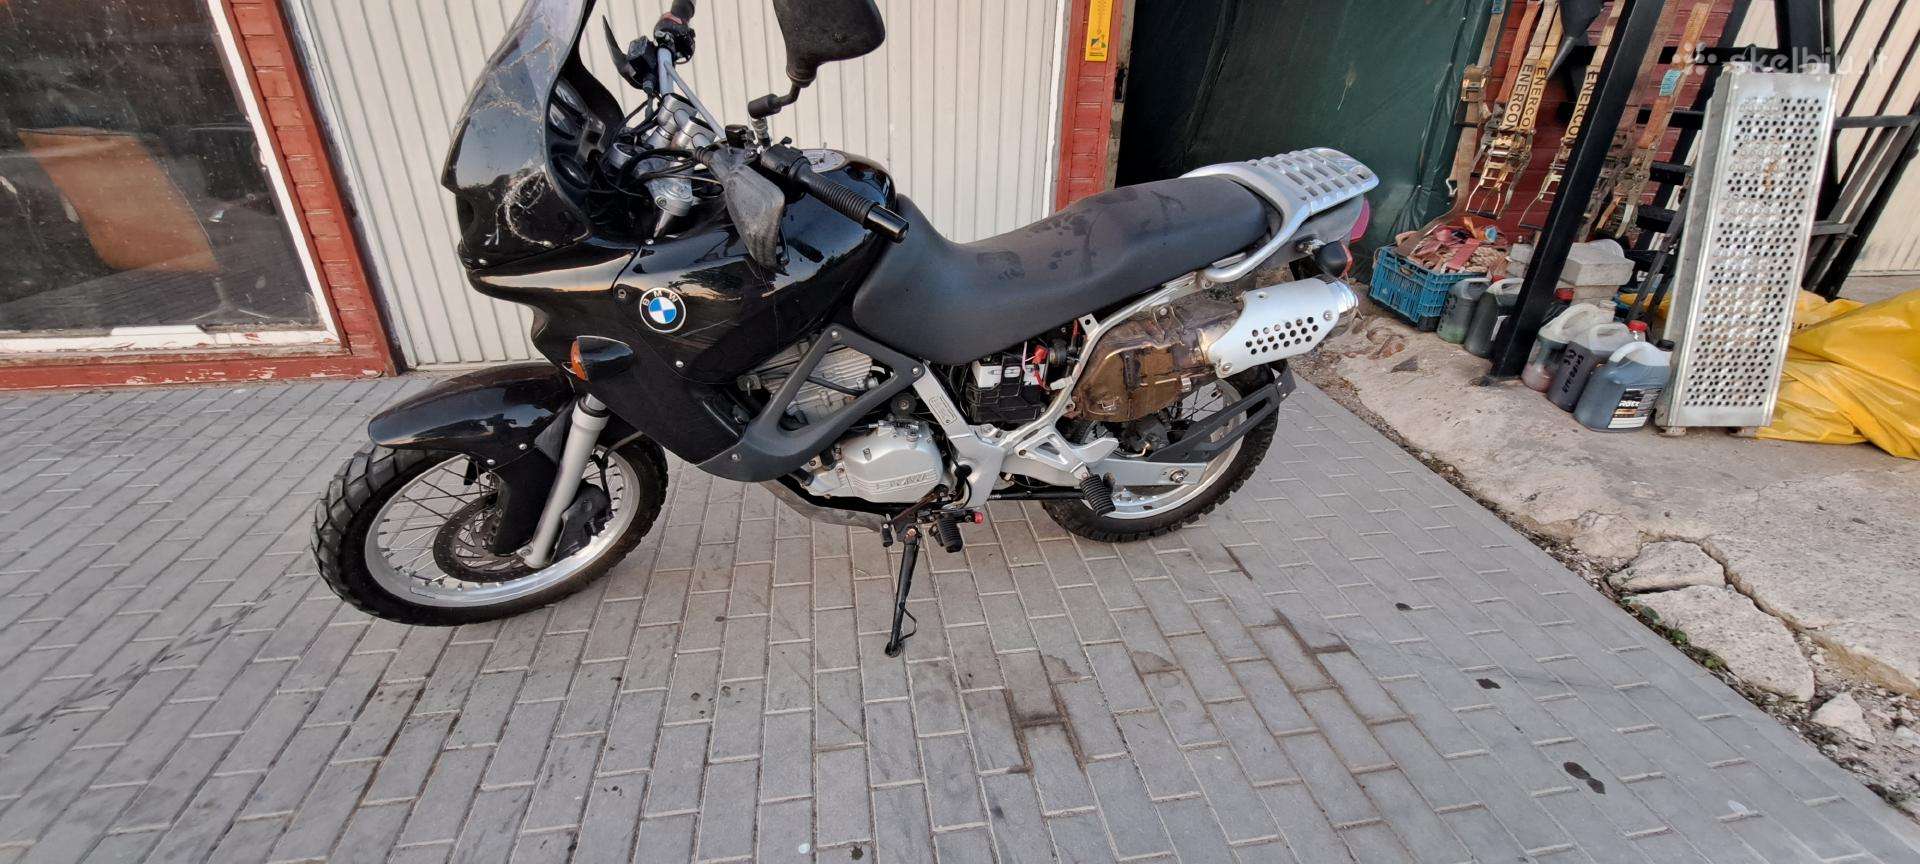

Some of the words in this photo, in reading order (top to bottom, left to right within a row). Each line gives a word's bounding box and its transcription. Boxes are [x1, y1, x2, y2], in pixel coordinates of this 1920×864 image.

[1505, 64, 1532, 131] ENERCON
[1521, 67, 1547, 131] ENERCO
[642, 290, 679, 306] BMW
